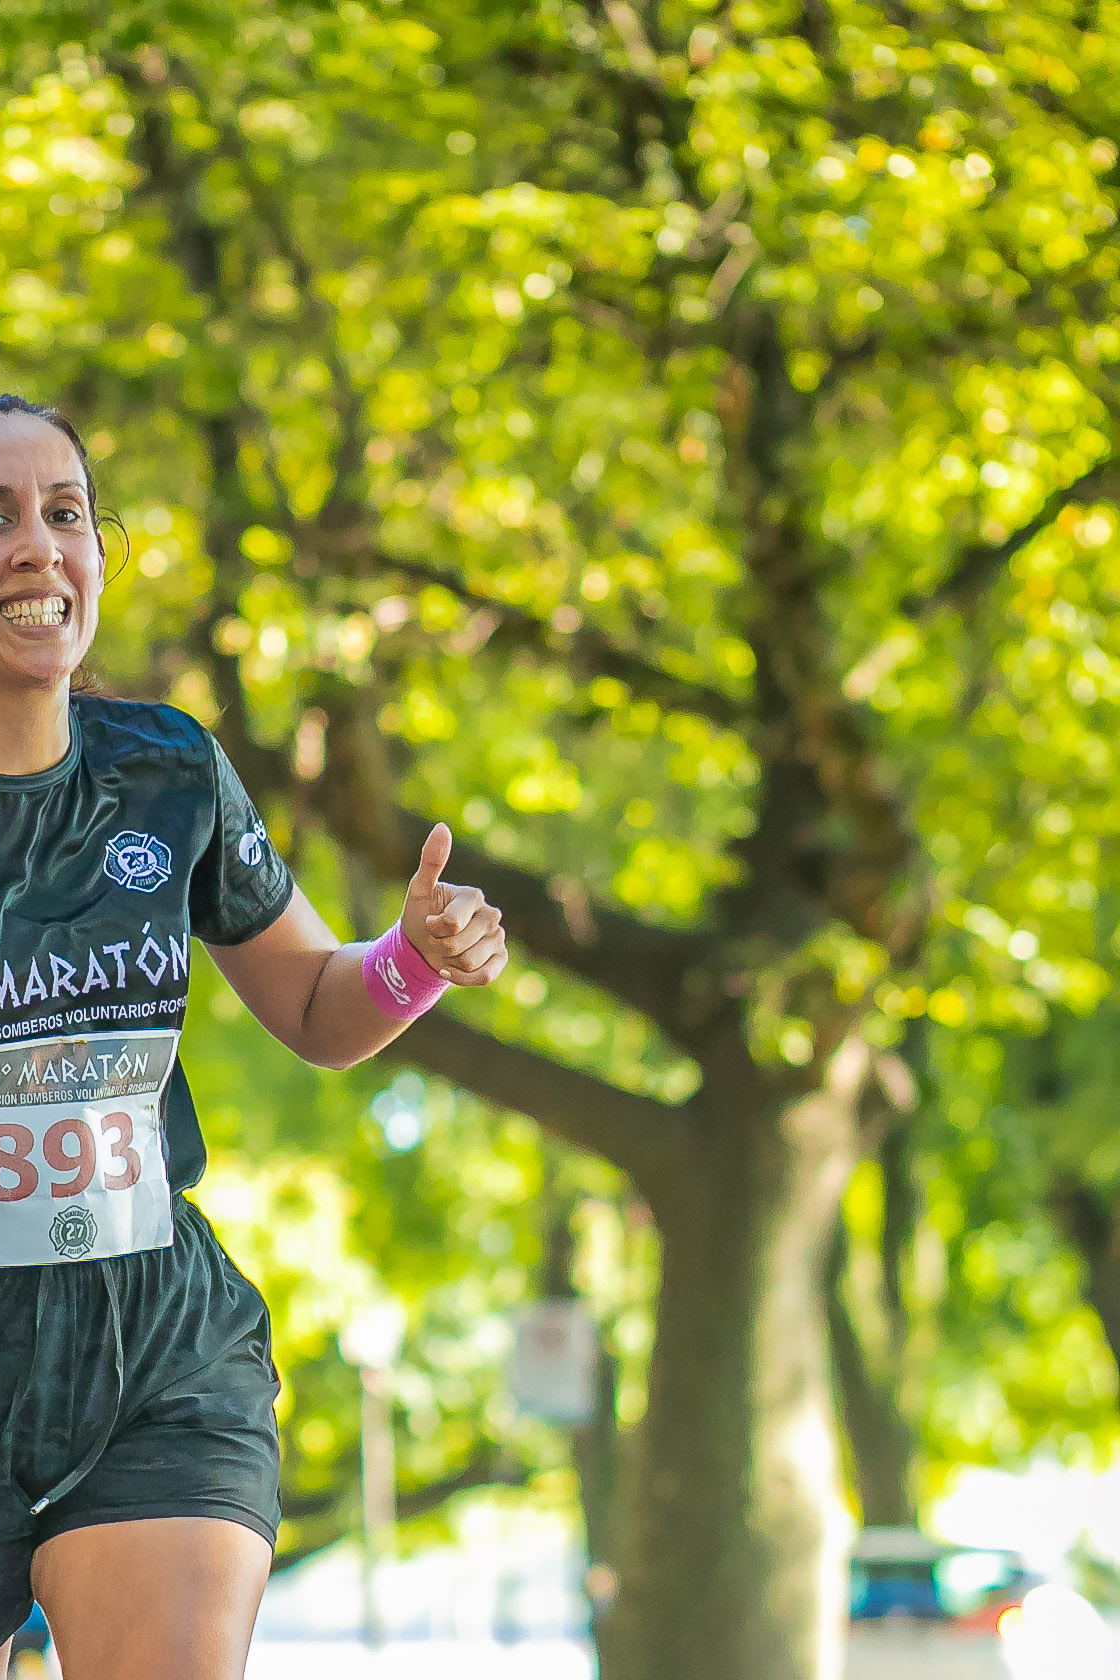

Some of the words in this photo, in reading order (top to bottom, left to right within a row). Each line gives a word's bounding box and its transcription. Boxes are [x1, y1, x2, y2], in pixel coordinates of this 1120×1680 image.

[65, 1001, 157, 1025] VOLUNTARIOS
[17, 1044, 150, 1087] MARATÓN
[20, 1089, 74, 1105] BOMBEROS
[75, 1083, 128, 1101] VOLUNTARIOS
[65, 1222, 85, 1241] 27
